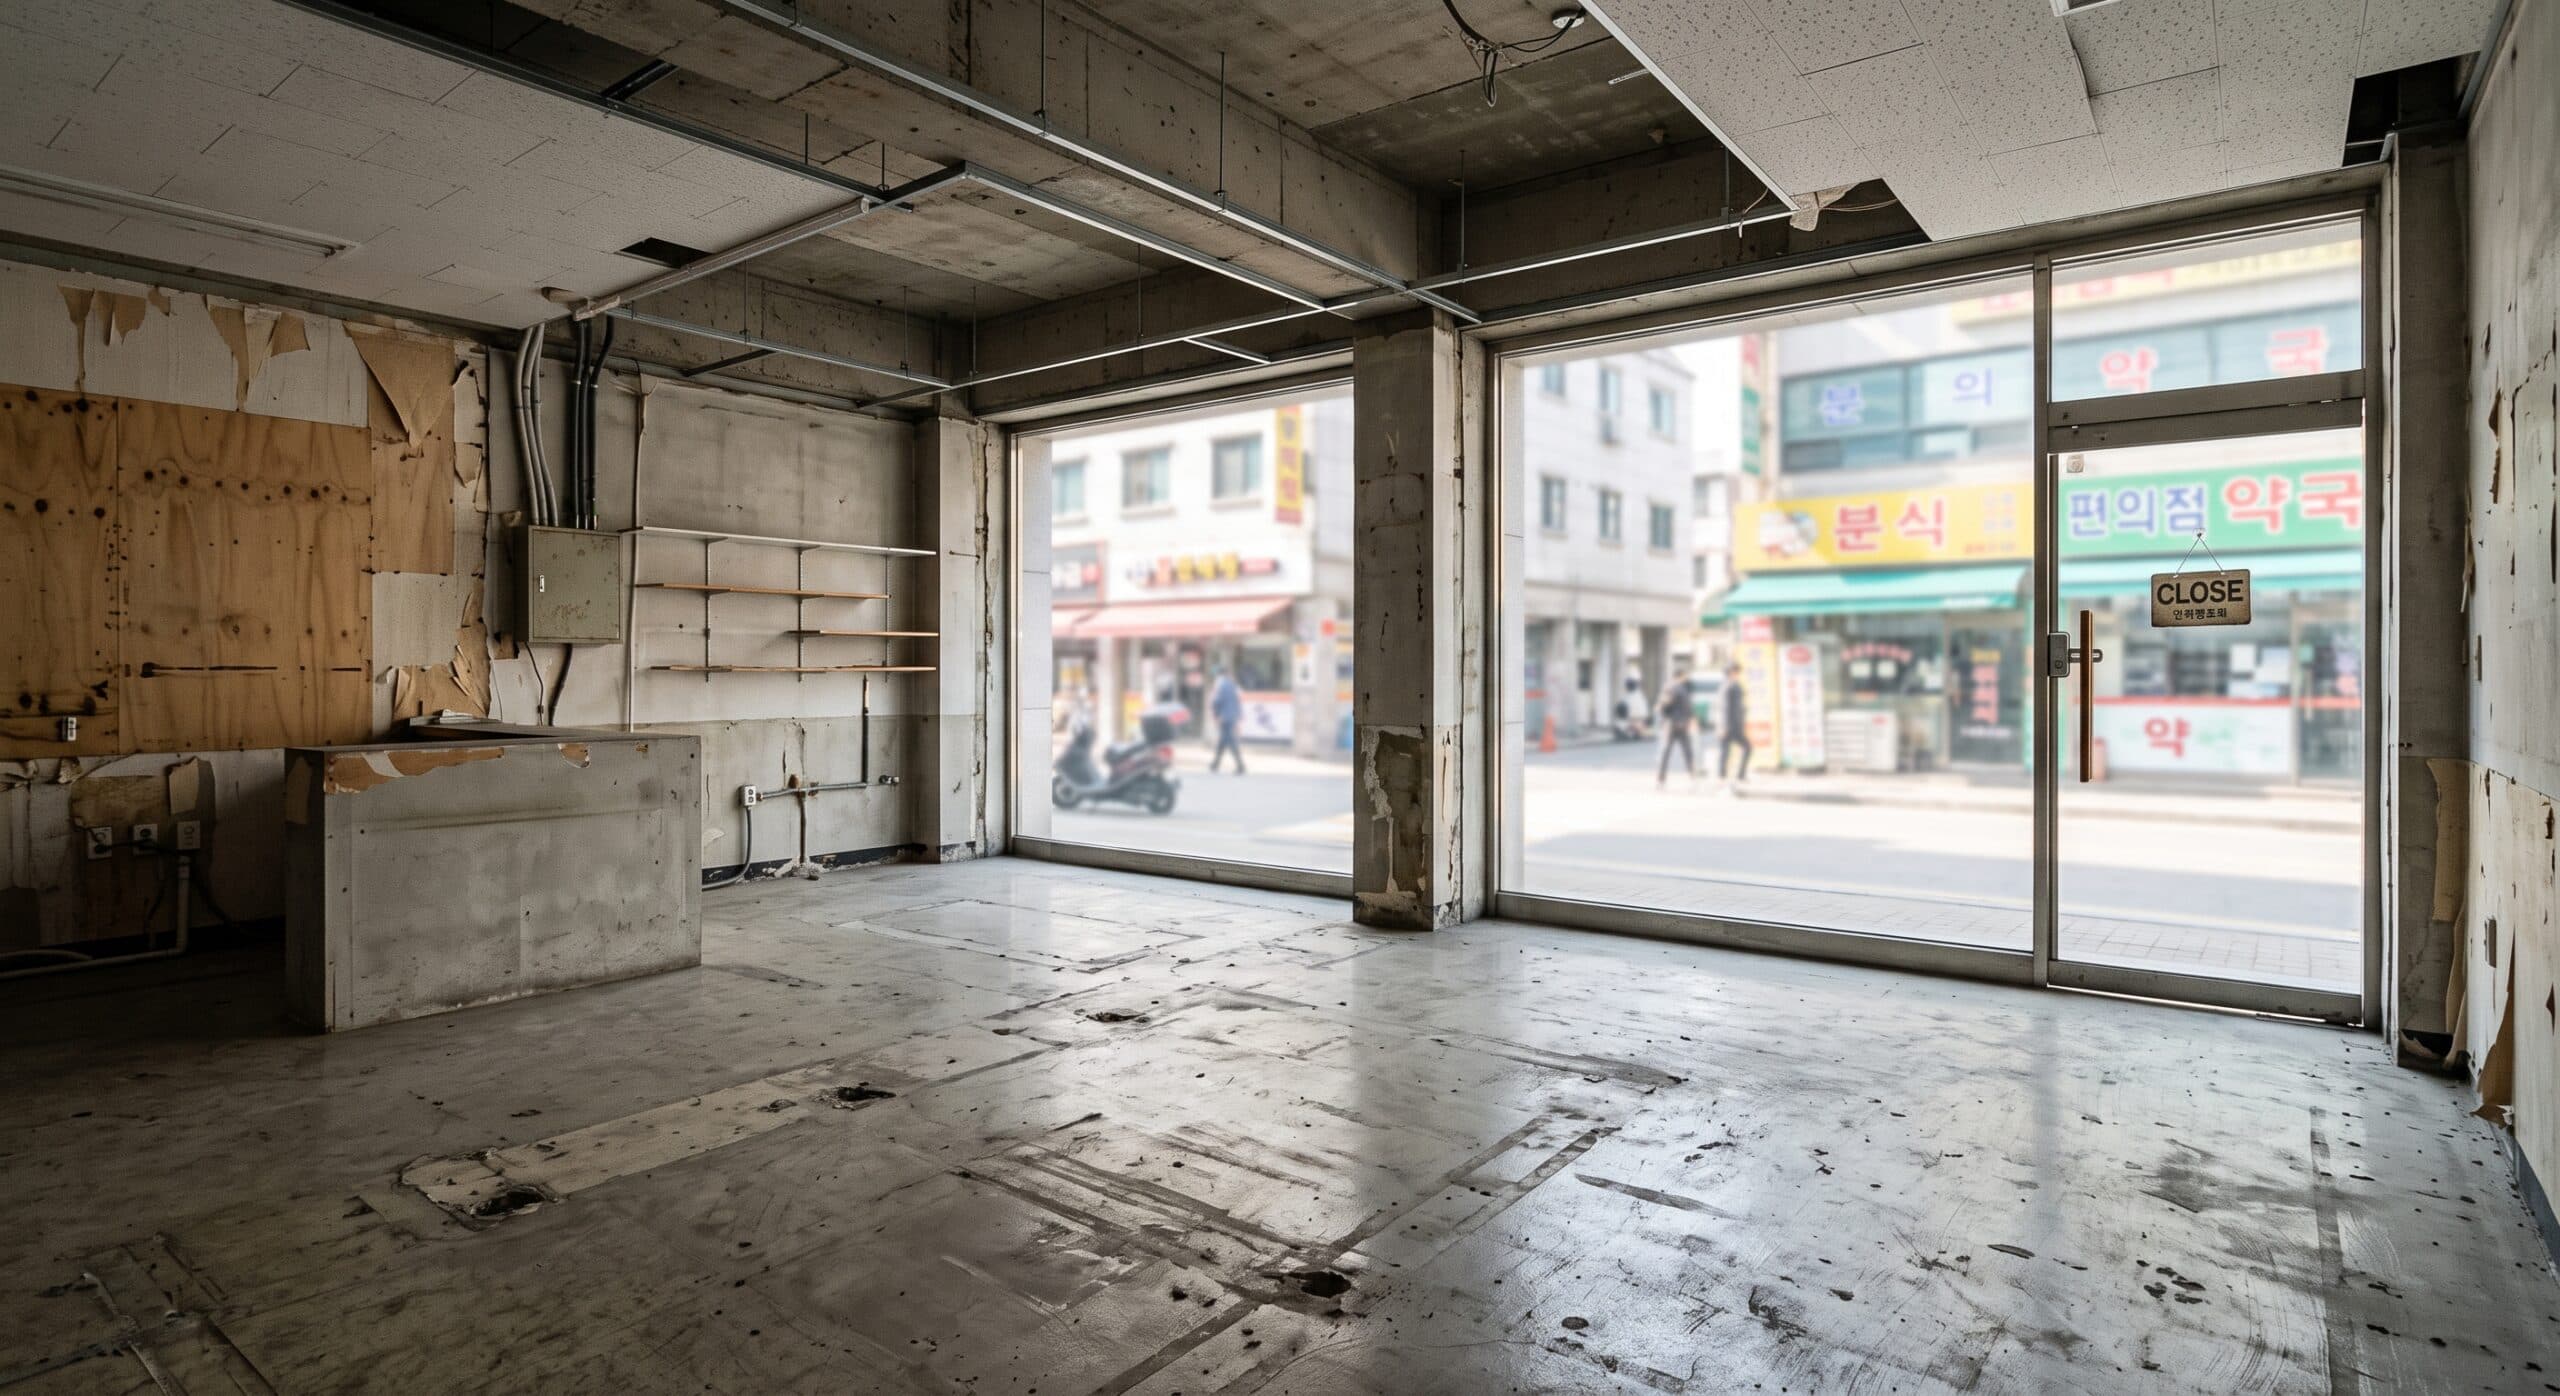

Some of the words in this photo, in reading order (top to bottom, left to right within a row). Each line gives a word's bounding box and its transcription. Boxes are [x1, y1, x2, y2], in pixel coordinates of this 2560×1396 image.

[2069, 485, 2205, 536] 편의점
[2225, 472, 2362, 532] 약국
[2157, 580, 2243, 605] CLOSE
[2144, 716, 2191, 758] 약
